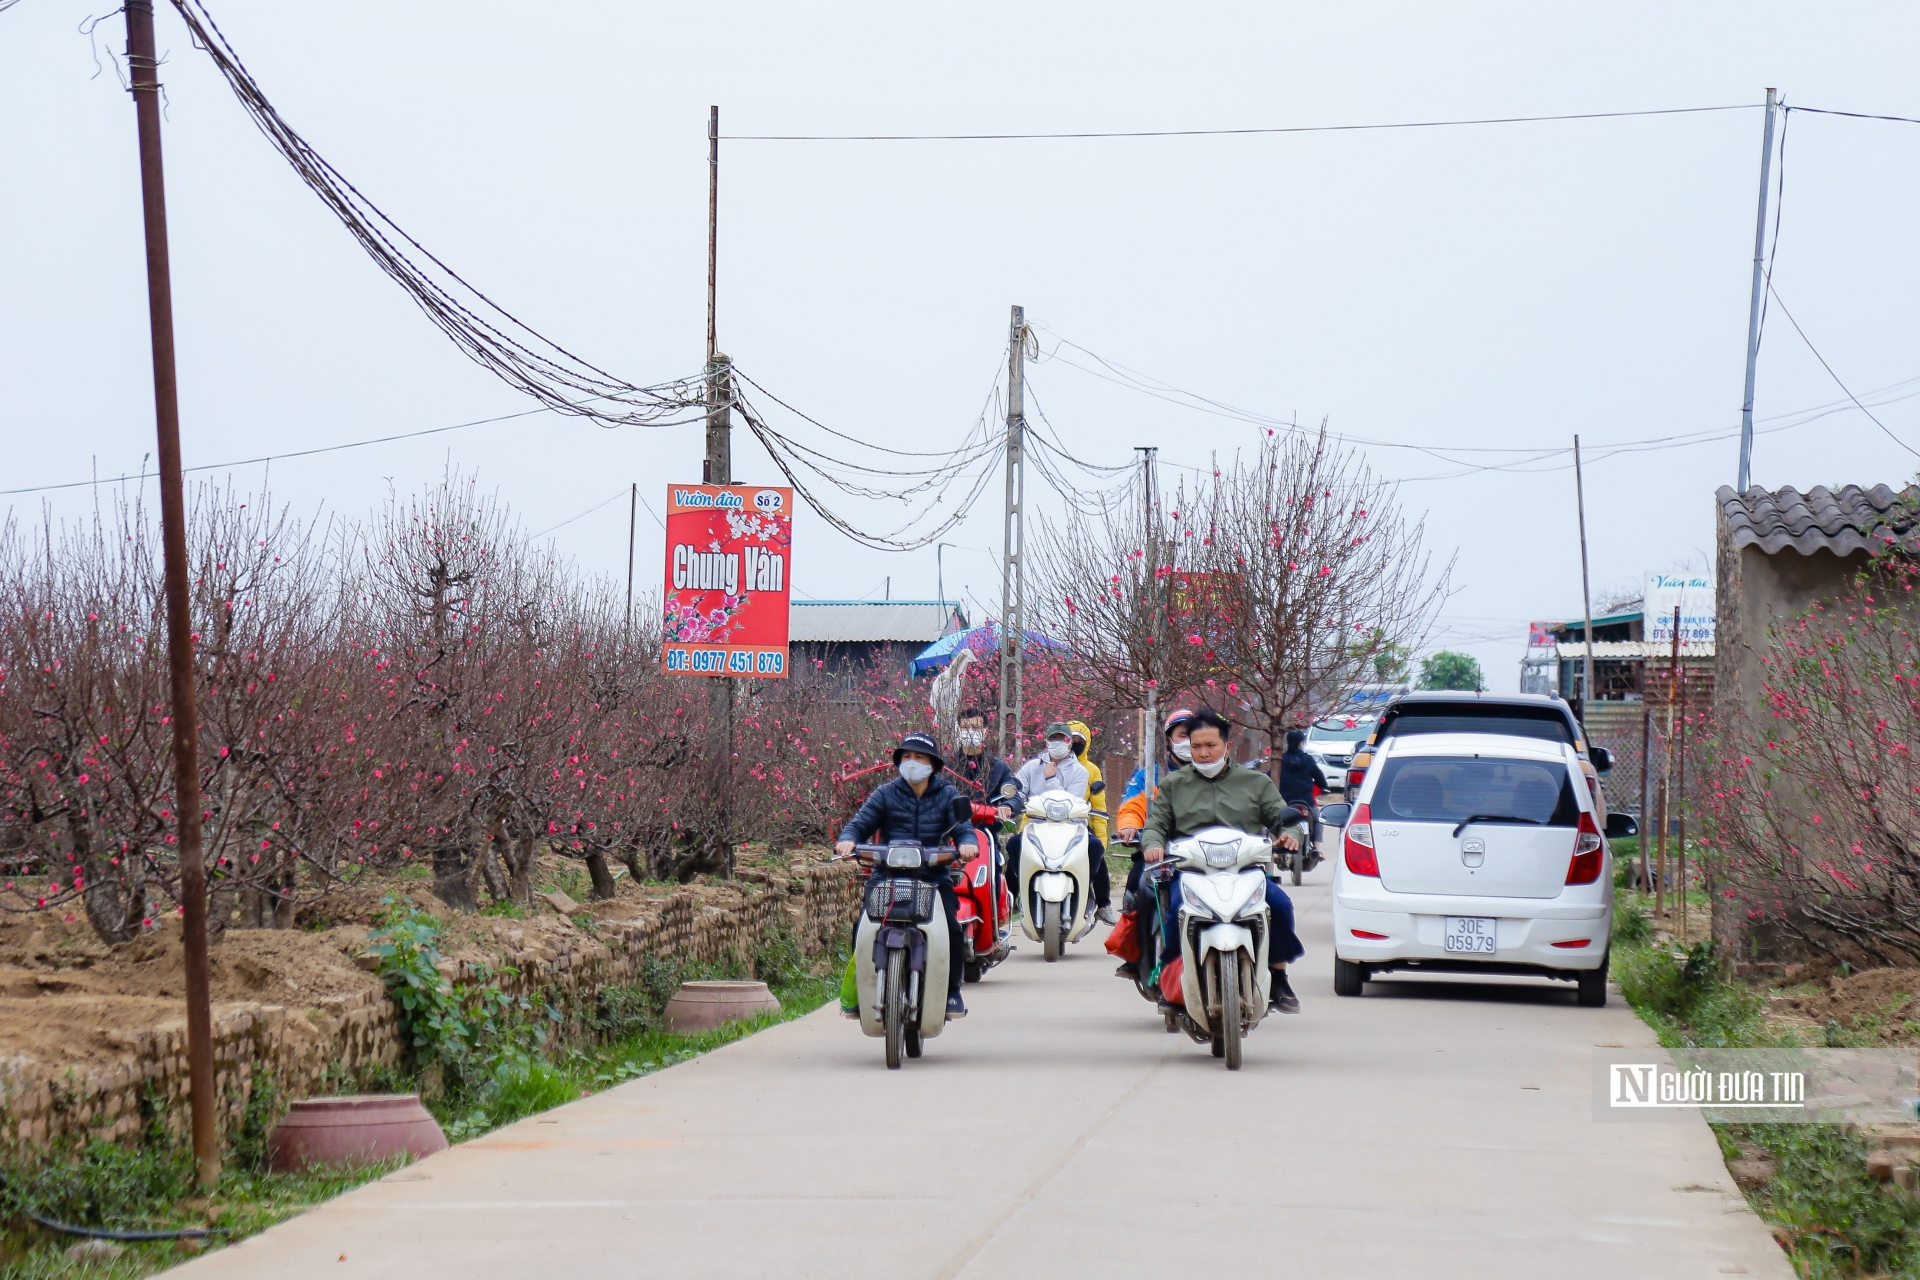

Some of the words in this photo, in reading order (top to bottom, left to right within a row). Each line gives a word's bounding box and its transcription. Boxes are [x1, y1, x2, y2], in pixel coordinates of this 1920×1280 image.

[675, 489, 713, 507] Vườn
[715, 491, 743, 508] đào
[757, 494, 770, 507] Số
[773, 496, 780, 507] 2
[672, 543, 740, 596] Chung
[744, 546, 784, 592] Vân
[667, 649, 690, 671] ĐT:
[693, 650, 726, 672] 0977
[728, 651, 754, 673] 451
[757, 652, 784, 673] 879
[1458, 919, 1484, 934] 30E
[1447, 935, 1494, 951] 059.79
